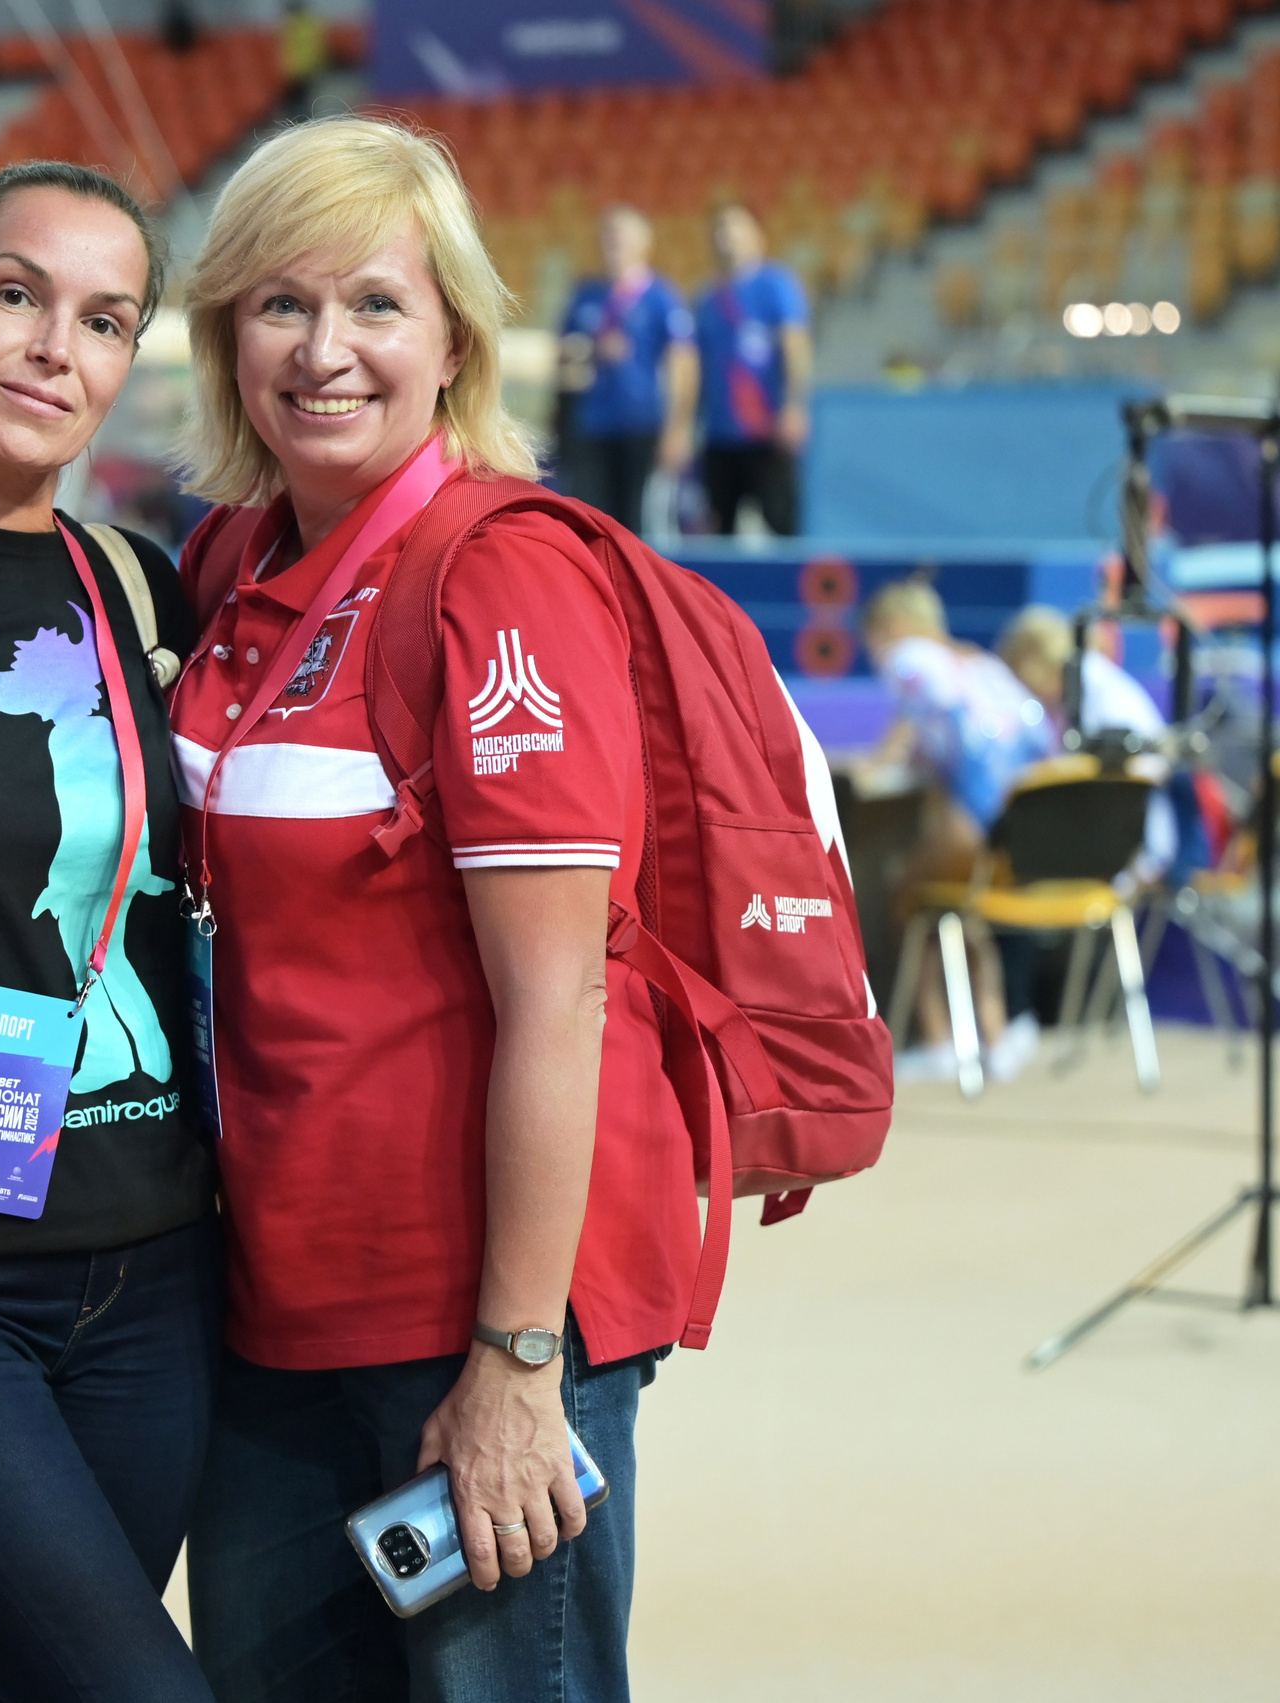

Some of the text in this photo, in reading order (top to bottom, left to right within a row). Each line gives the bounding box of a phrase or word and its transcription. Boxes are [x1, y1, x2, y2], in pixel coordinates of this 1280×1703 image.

[472, 729, 564, 754] МОСКОВСКИЙ
[473, 753, 520, 776] СПОРТ
[774, 896, 833, 918] МОСКОВСКИЙ
[776, 914, 806, 934] СПОРТ
[24, 1106, 40, 1132] 2025
[60, 1091, 181, 1129] amiroqua
[0, 1187, 12, 1196] ВТБ
